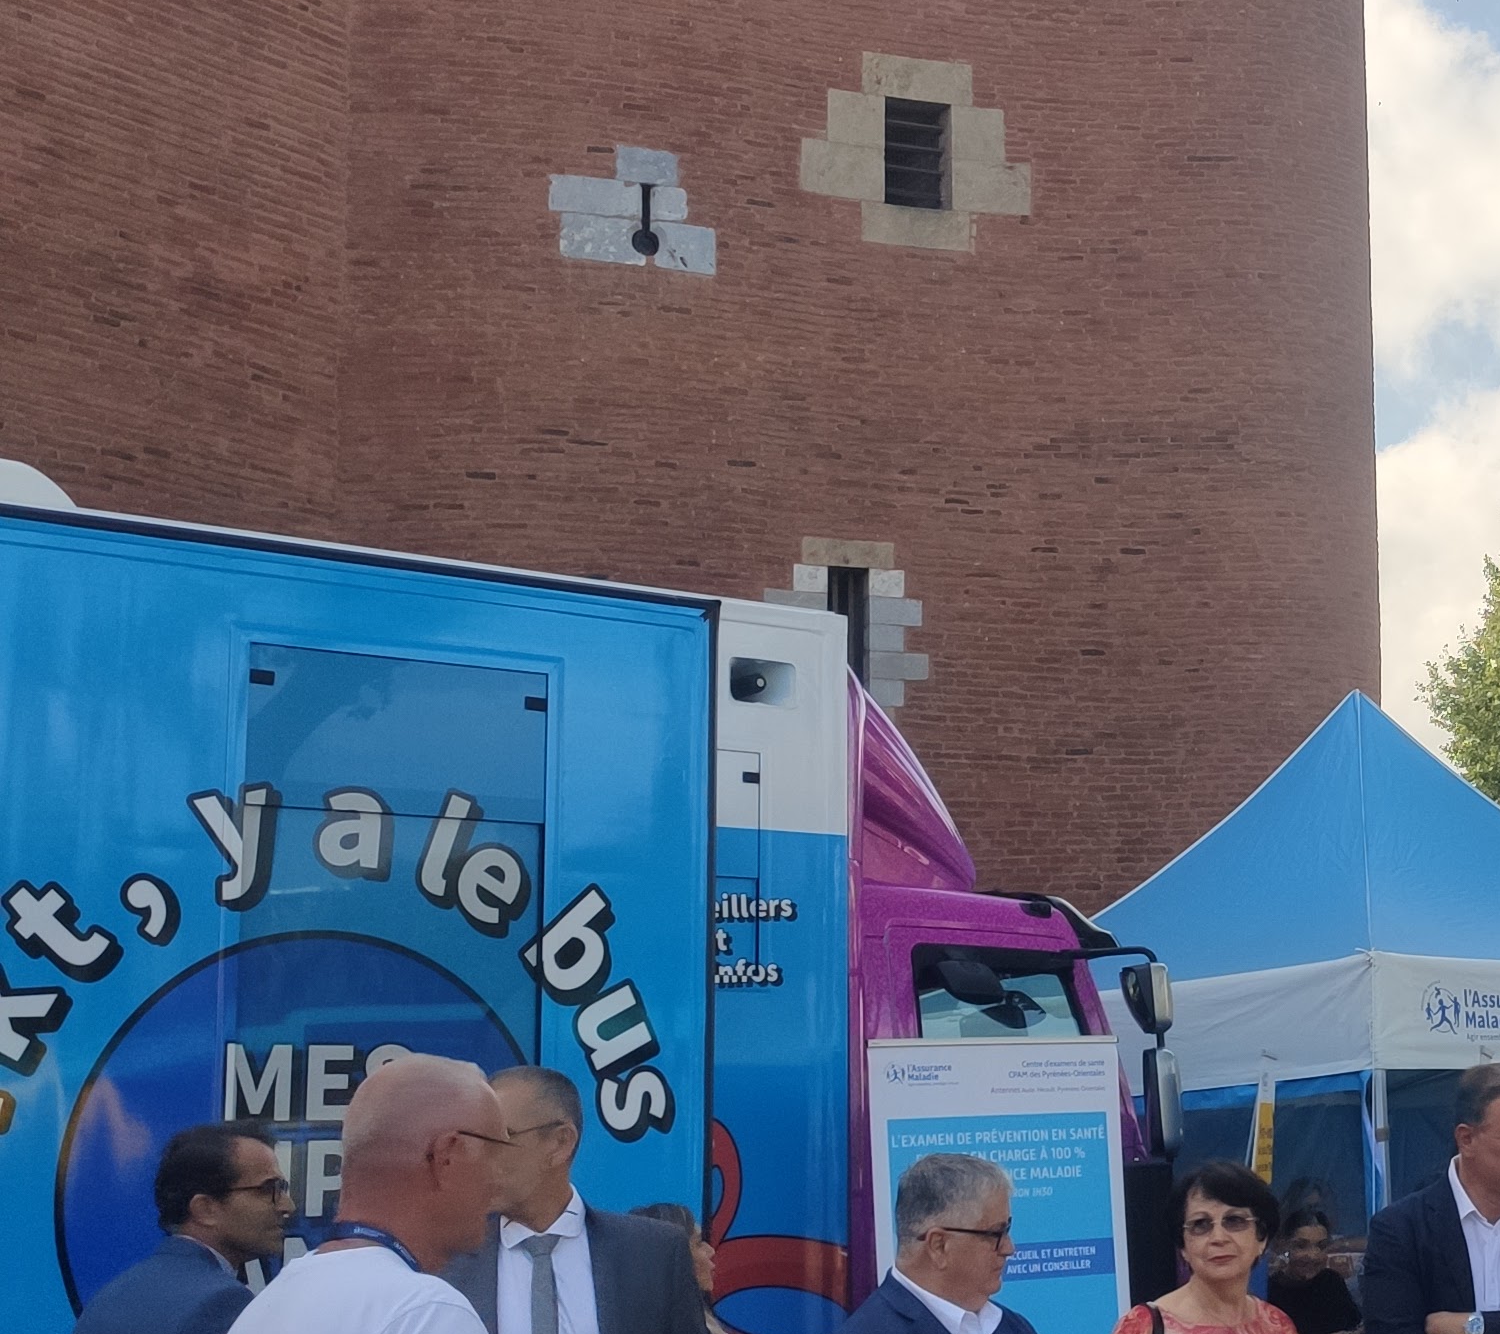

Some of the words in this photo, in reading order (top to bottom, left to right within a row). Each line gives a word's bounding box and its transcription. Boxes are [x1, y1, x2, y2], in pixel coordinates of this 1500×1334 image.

[190, 783, 277, 907] y
[314, 788, 389, 877] a
[416, 790, 529, 933] le
[521, 884, 673, 1140] bus
[907, 1073, 939, 1082] Maladie
[891, 1133, 954, 1149] L'EXAMEN
[957, 1132, 973, 1145] DE
[975, 1128, 1050, 1144] PRÉVENTION
[1051, 1129, 1067, 1142] EN
[1069, 1124, 1105, 1141] SANTÉ
[989, 1149, 1037, 1163] CHARGE
[1040, 1146, 1049, 1161] À
[1050, 1147, 1072, 1160] 100
[1074, 1146, 1086, 1159] %
[1030, 1165, 1083, 1180] MALADIE
[1041, 1249, 1051, 1259] ET
[1053, 1246, 1096, 1258] ENTRETIEN
[1006, 1263, 1028, 1275] AVEC
[1029, 1262, 1041, 1273] UN
[1042, 1259, 1091, 1272] CONSEILLER
